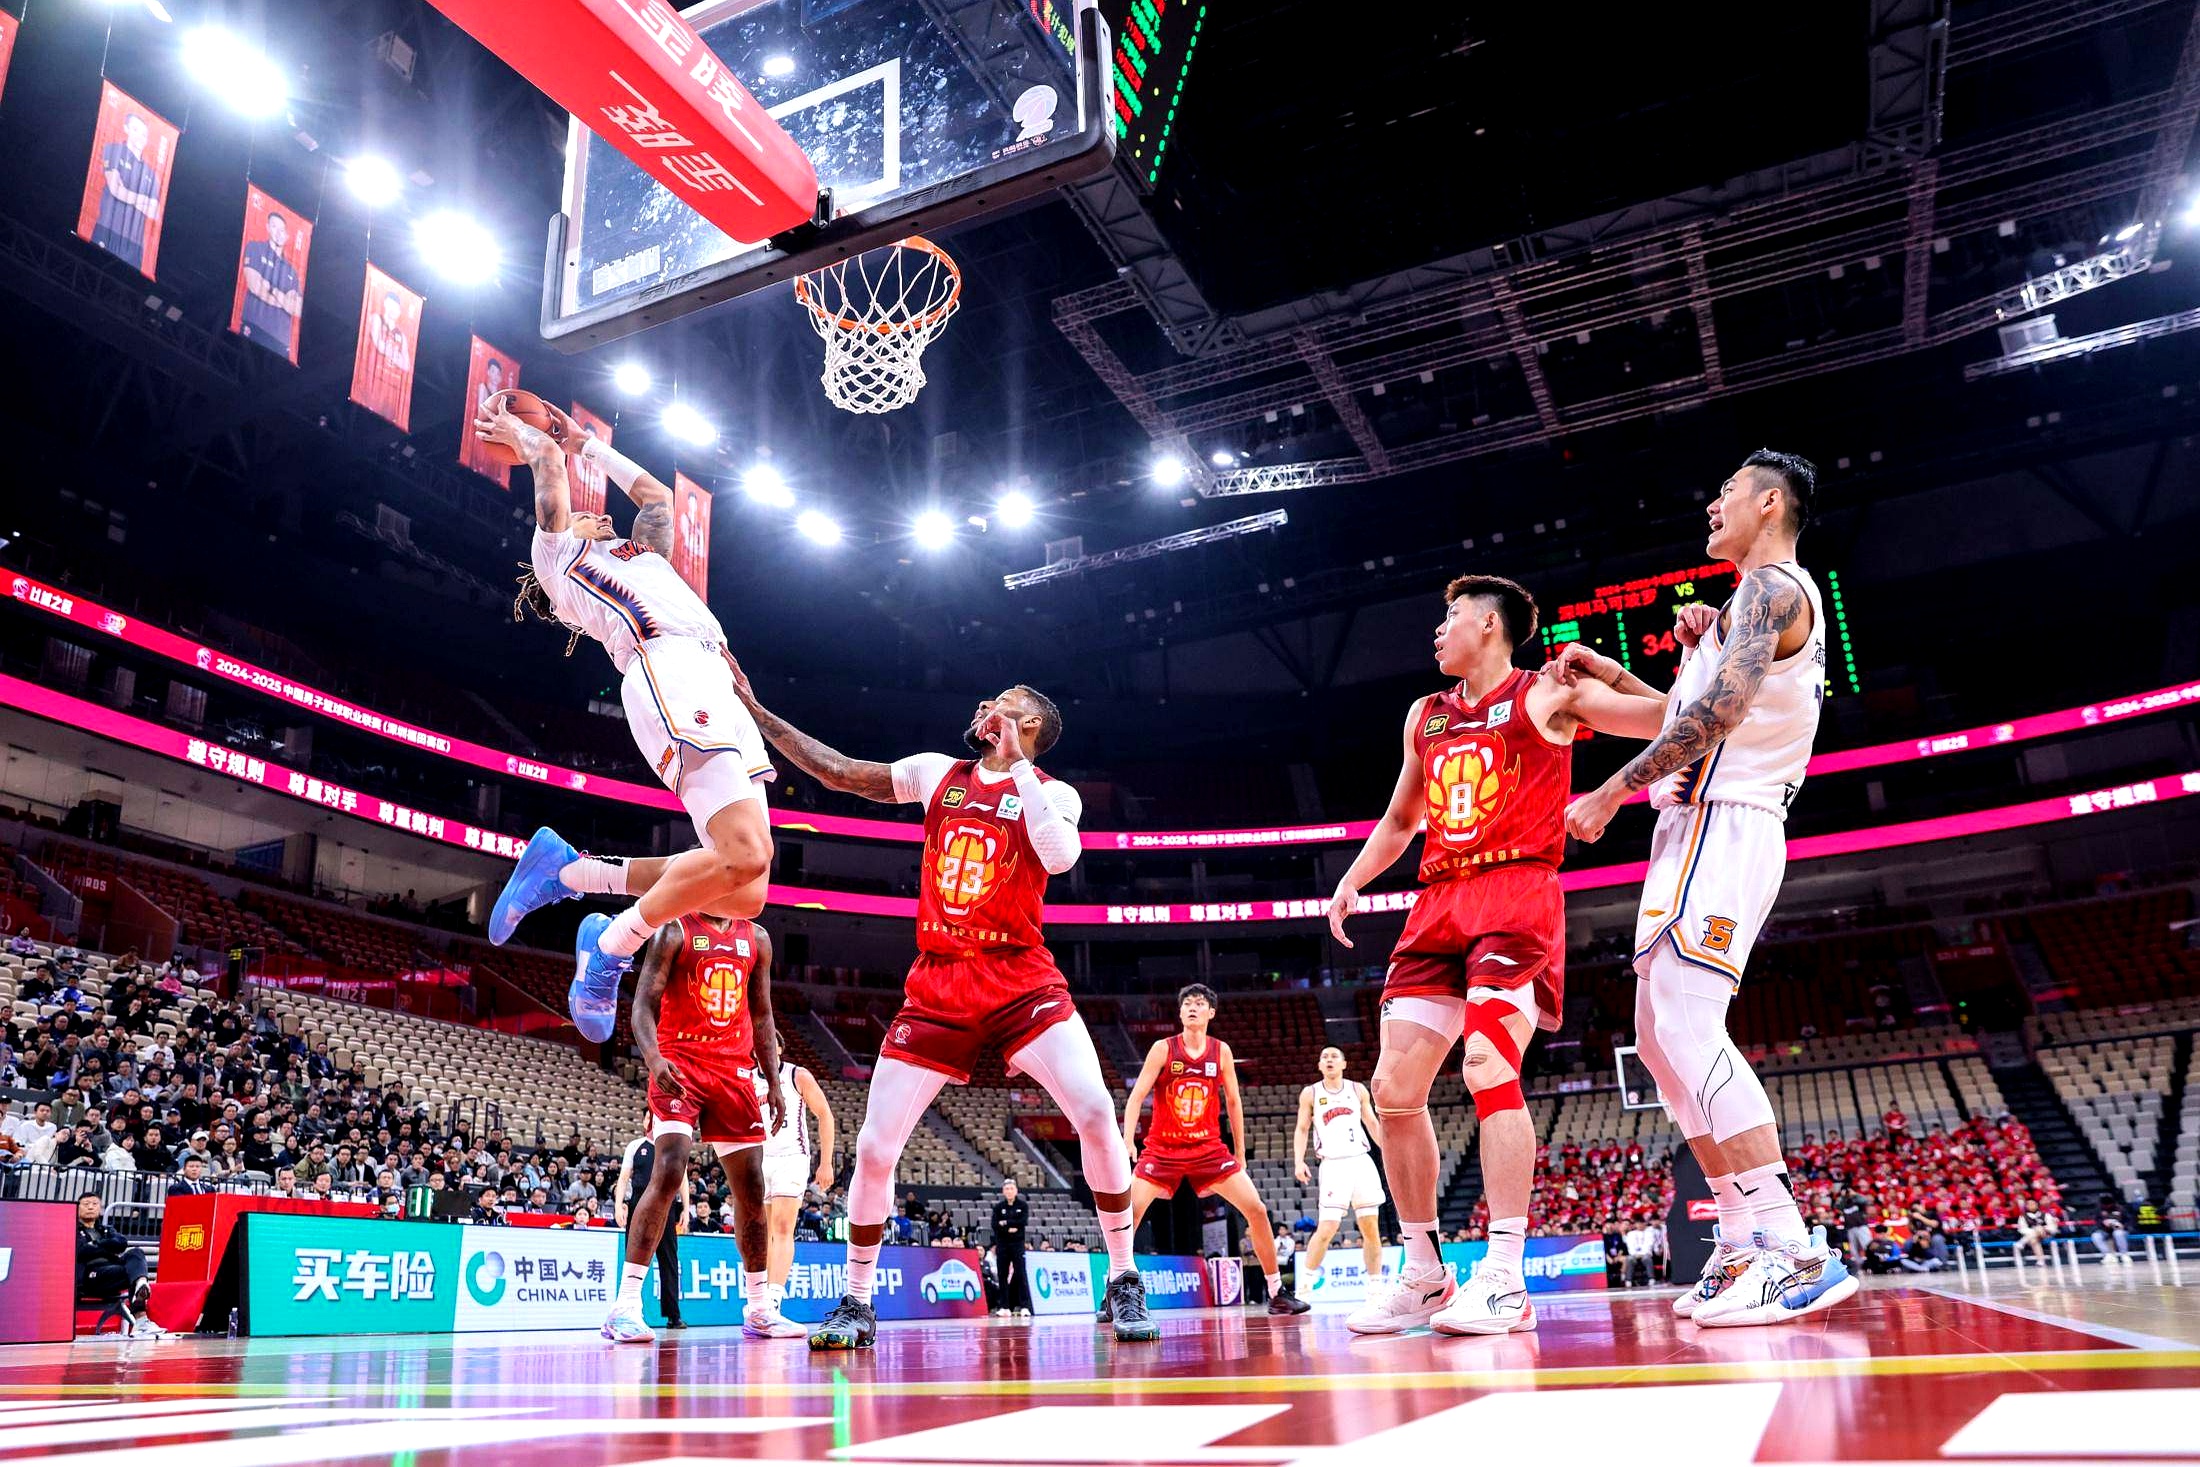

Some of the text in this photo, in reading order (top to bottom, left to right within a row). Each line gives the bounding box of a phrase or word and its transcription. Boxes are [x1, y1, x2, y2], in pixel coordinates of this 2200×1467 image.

[1674, 582, 1695, 597] VS
[1641, 630, 1676, 656] 34
[216, 658, 282, 693] 2024-2025
[187, 739, 266, 784] 遵守规则
[288, 772, 358, 812] 尊重对手
[378, 802, 445, 839] 尊重裁判
[1450, 782, 1473, 820] 8
[940, 856, 985, 895] 23
[707, 988, 737, 1013] 35
[292, 1247, 436, 1301] 买车险
[514, 1256, 606, 1283] 中国人寿
[1052, 1270, 1087, 1285] 中国人寿
[1331, 1266, 1391, 1278] 中国寿
[517, 1288, 607, 1302] CHINA LIFE
